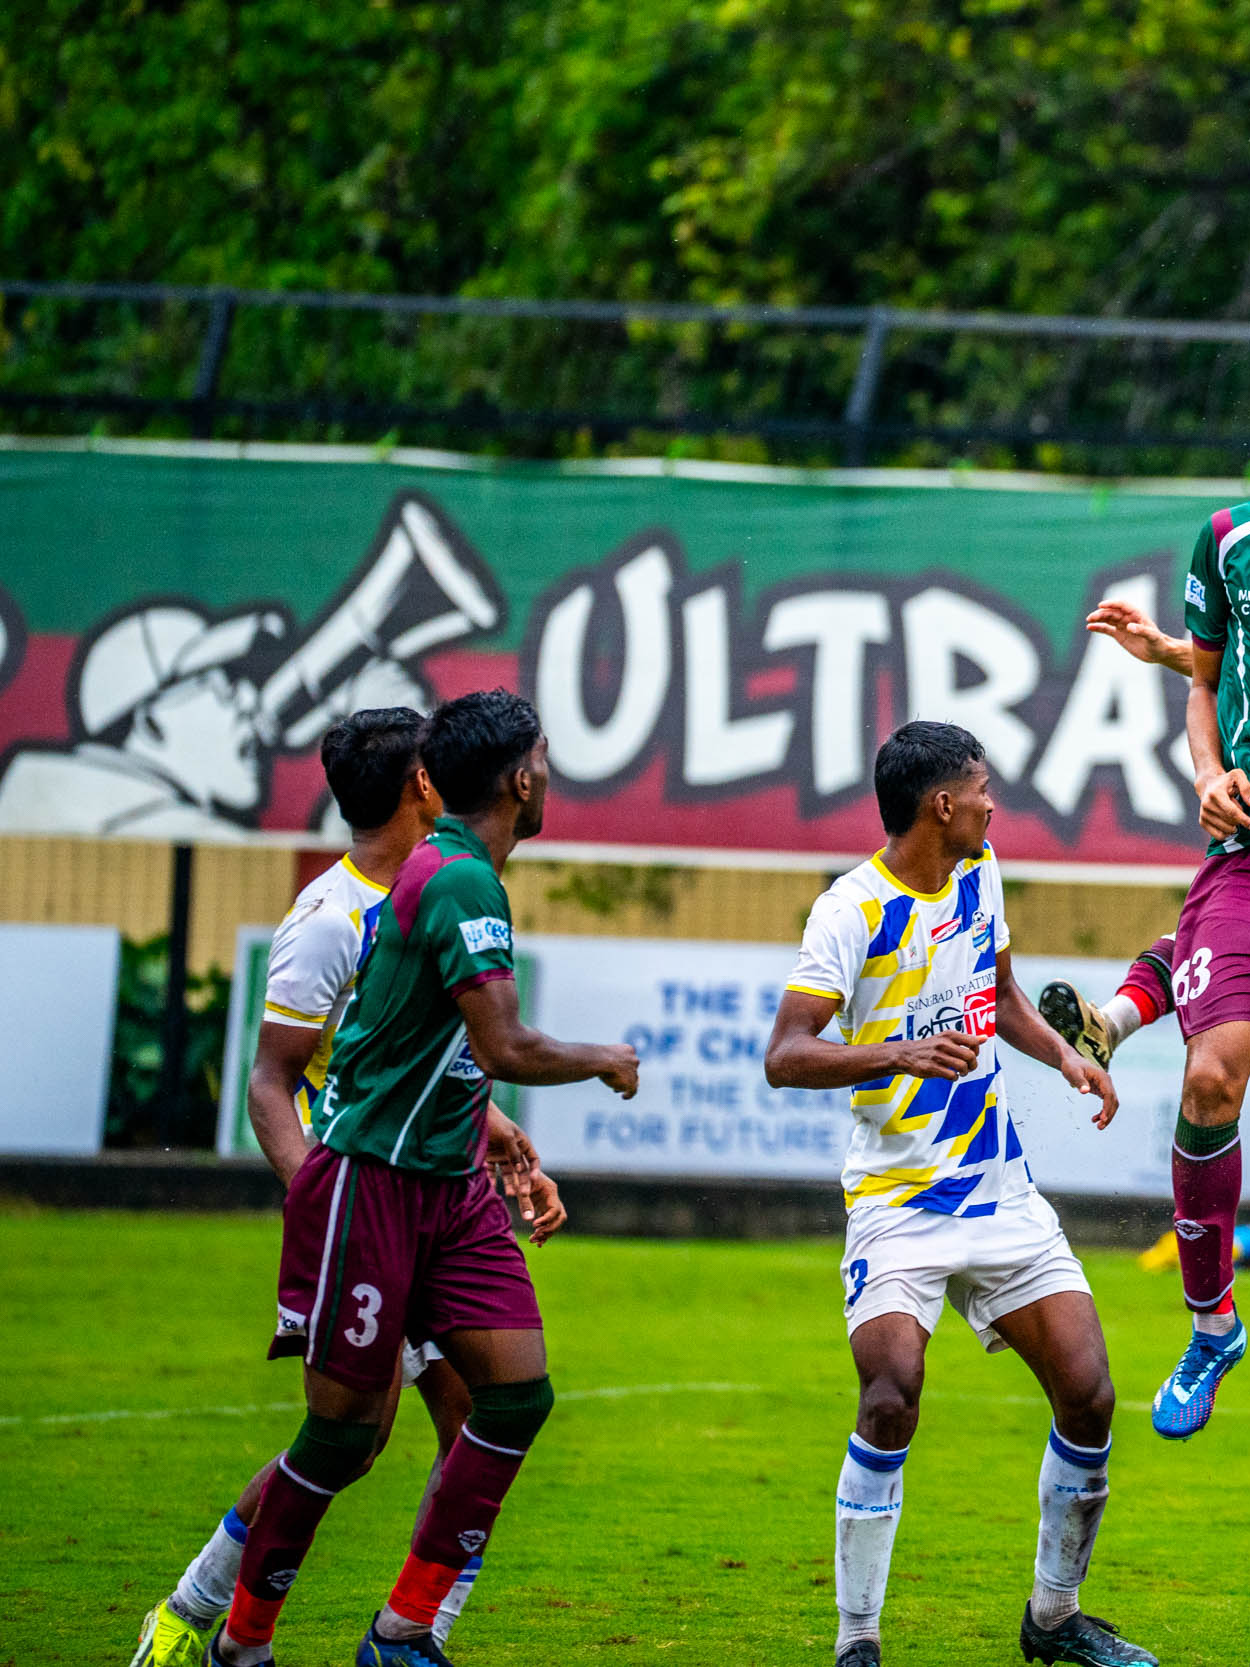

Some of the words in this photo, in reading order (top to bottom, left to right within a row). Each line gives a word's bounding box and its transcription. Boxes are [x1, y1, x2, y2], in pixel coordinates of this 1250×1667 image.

[1172, 947, 1213, 1006] 63
[659, 980, 740, 1014] THE
[624, 1024, 681, 1058] OF
[670, 1075, 740, 1107] THE
[585, 1112, 668, 1149] FOR
[679, 1114, 834, 1151] FUTURE
[344, 1283, 382, 1348] 3
[836, 1496, 901, 1513] RAK-ONLY
